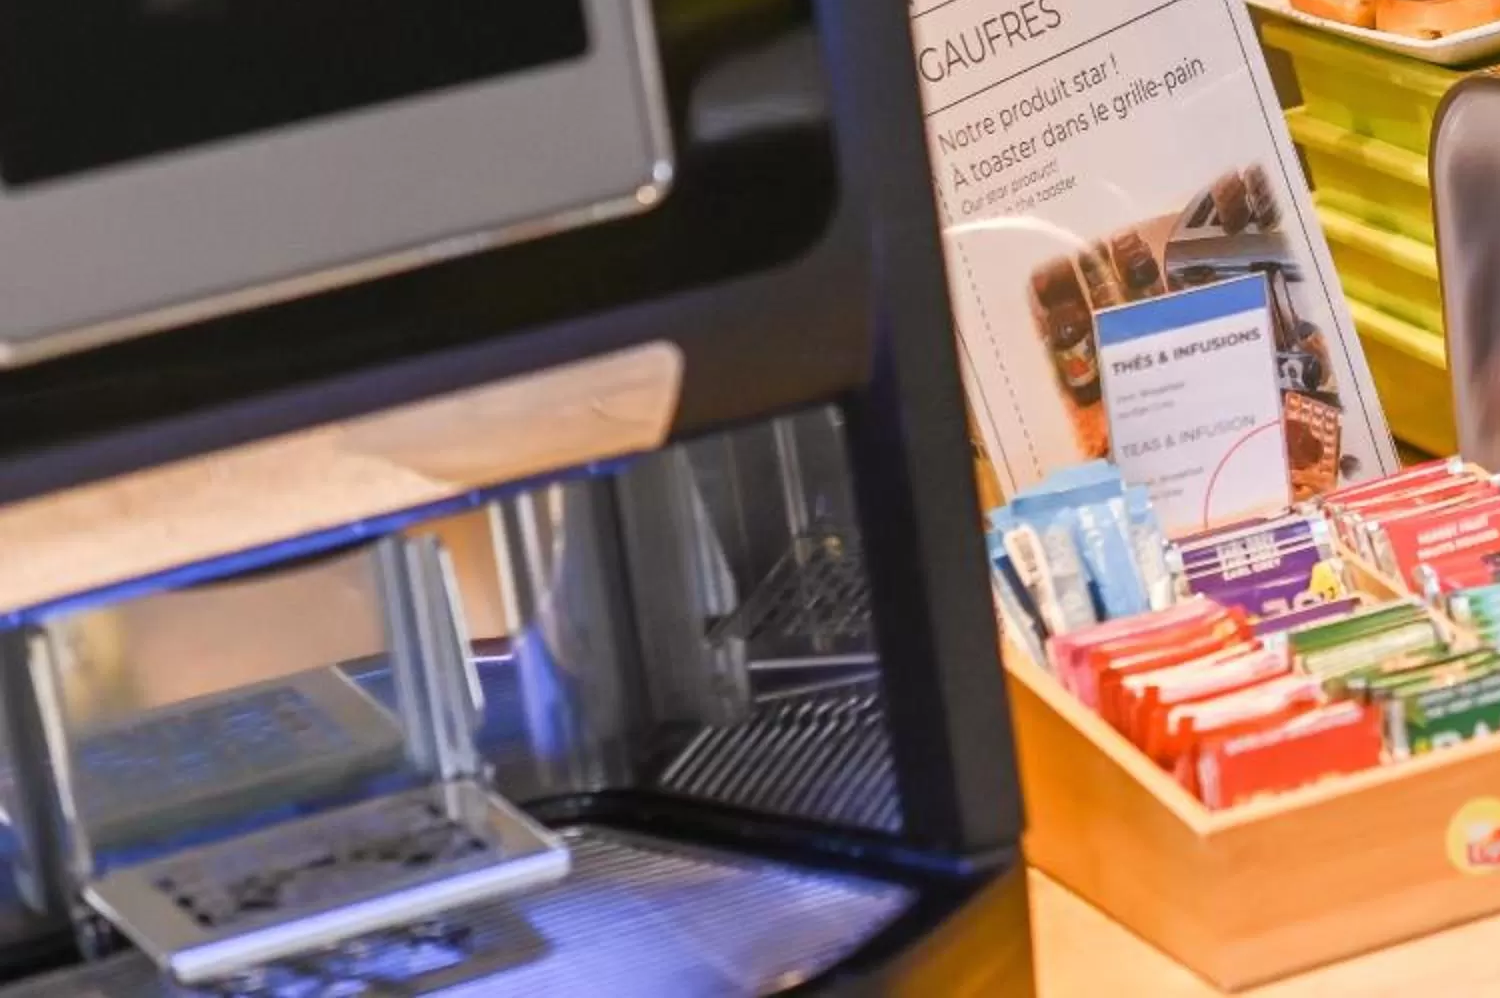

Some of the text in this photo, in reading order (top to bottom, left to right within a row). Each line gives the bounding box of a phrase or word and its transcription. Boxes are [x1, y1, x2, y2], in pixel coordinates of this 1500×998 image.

[937, 52, 1121, 155] Notre produit star !
[950, 56, 1207, 192] À toaster dans le grille-pain
[1112, 327, 1262, 377] THÉS & INFUSIONS
[1121, 437, 1162, 459] TEAS
[1165, 433, 1177, 448] &
